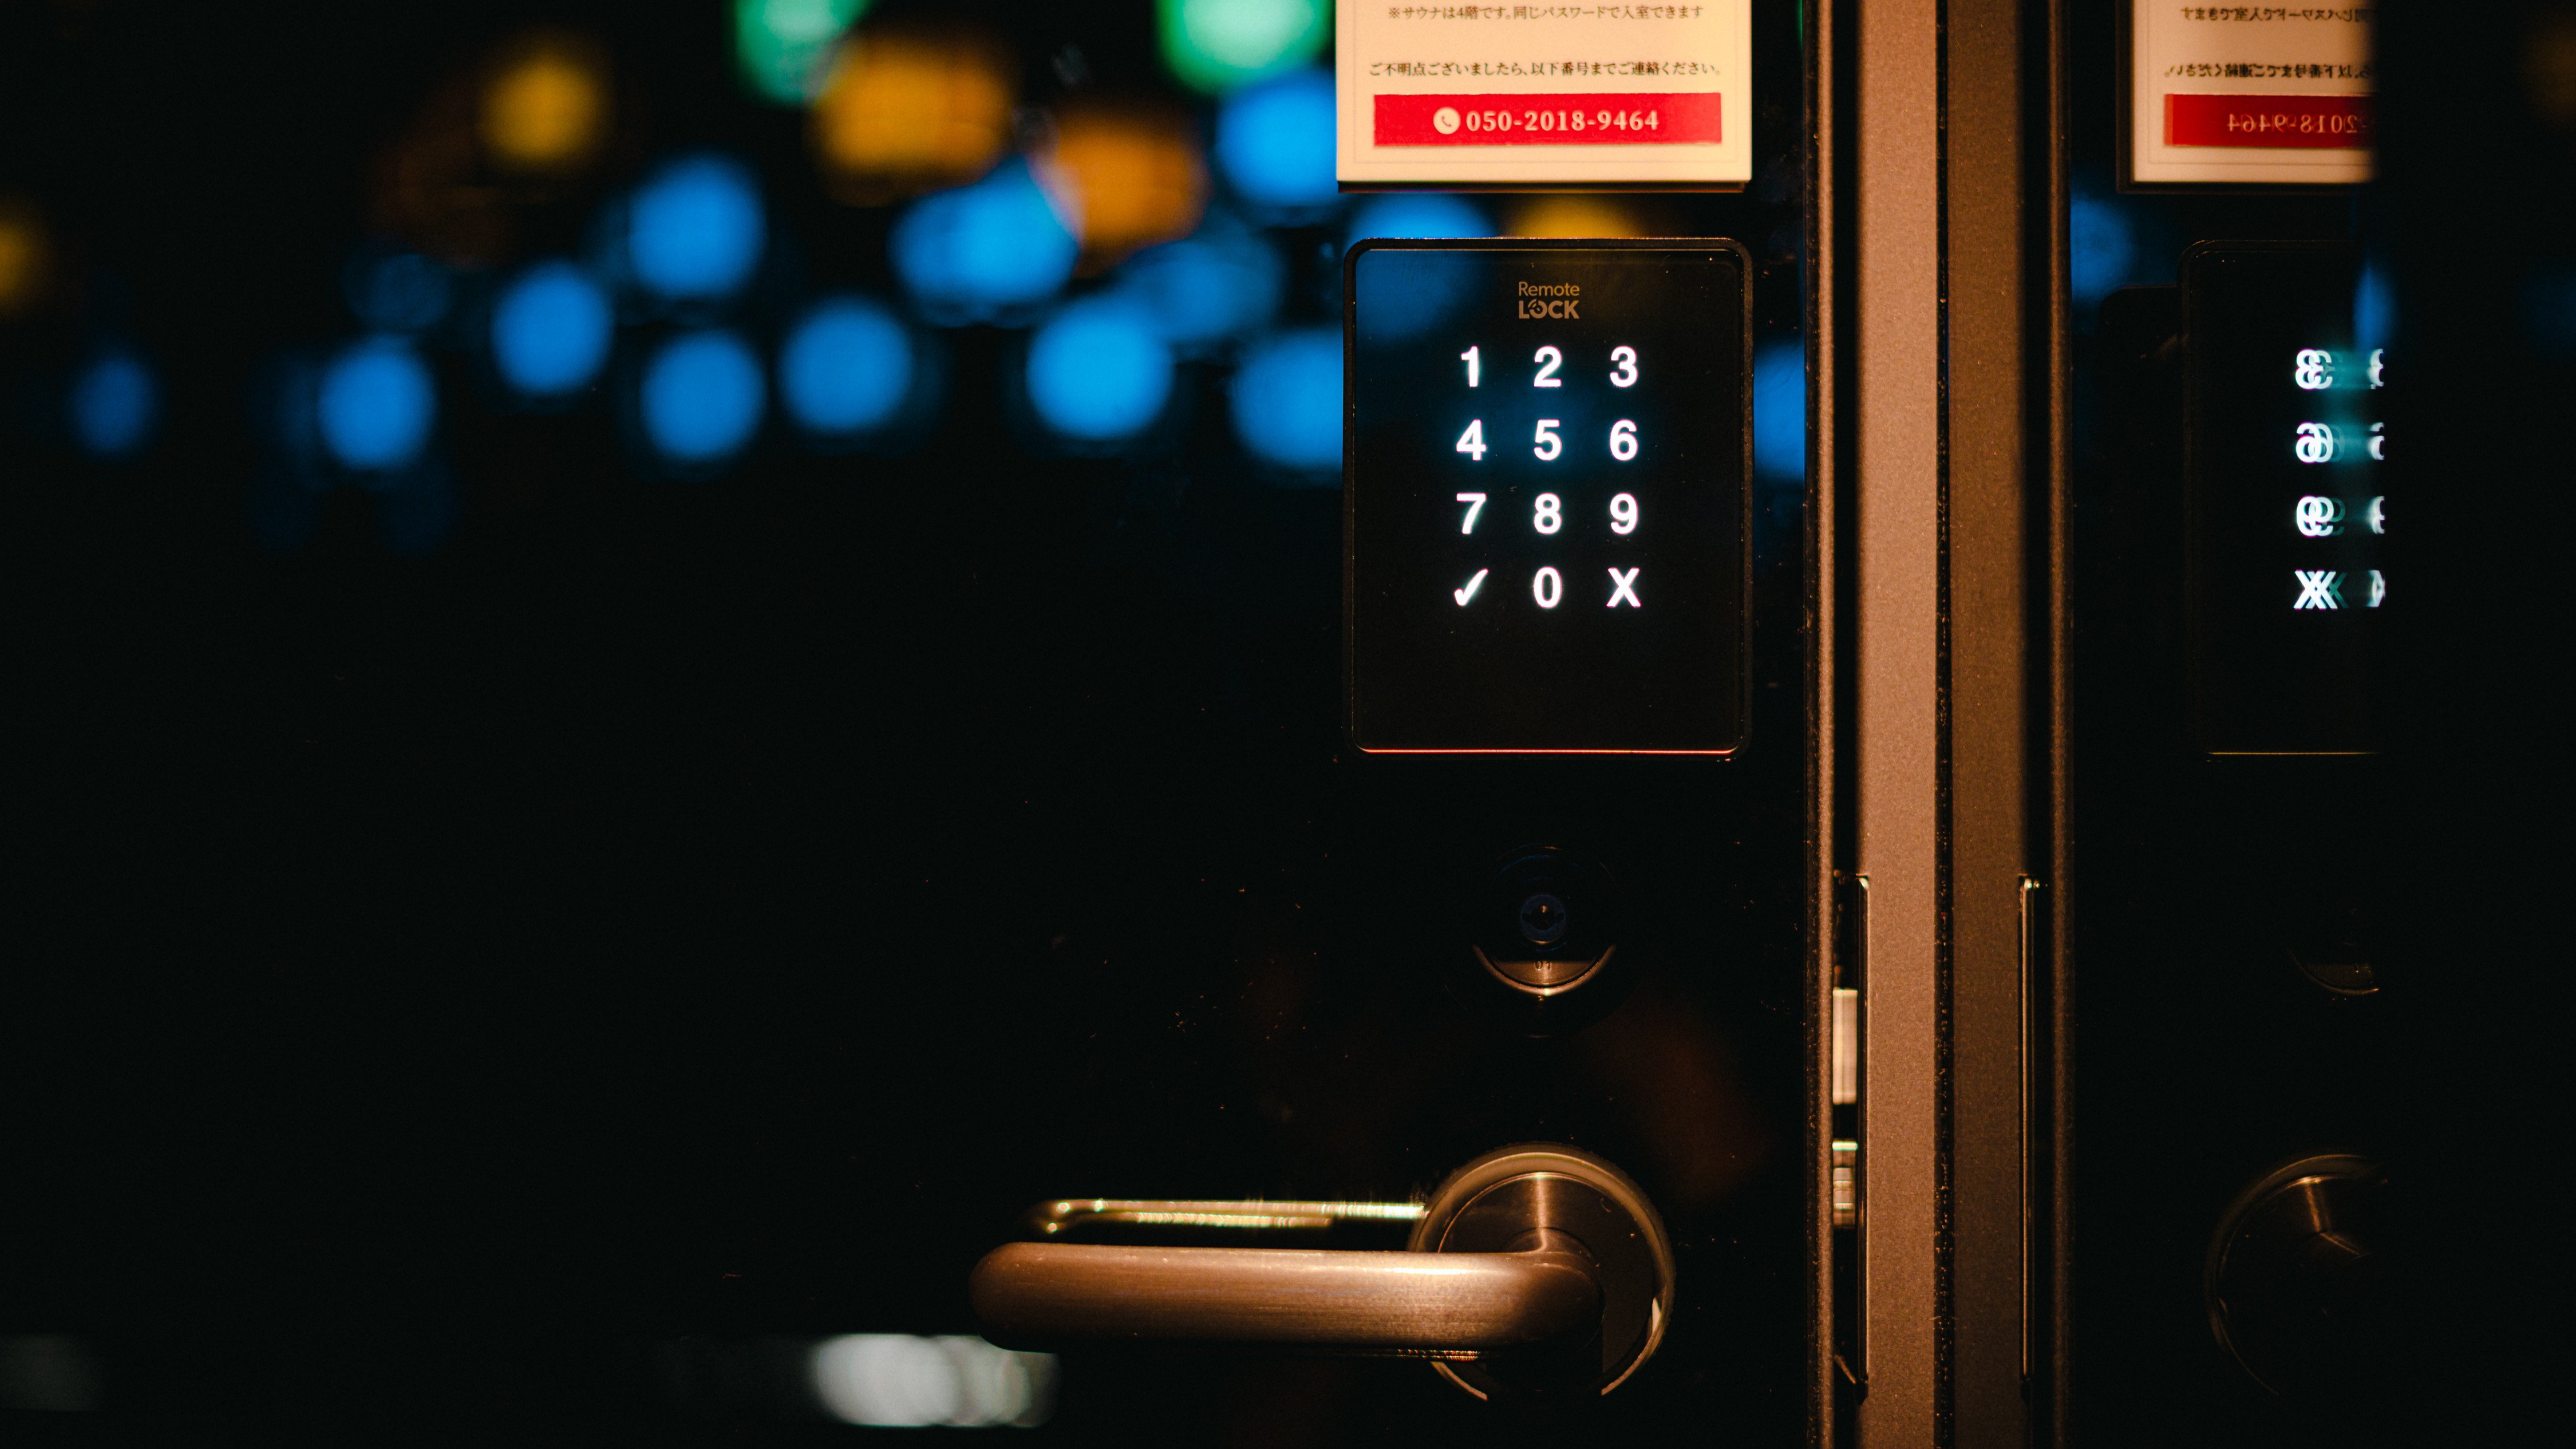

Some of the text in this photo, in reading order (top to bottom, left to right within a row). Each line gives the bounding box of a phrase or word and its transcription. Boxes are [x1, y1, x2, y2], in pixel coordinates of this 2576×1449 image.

[1466, 109, 1660, 132] 050-2018-9464
[1519, 281, 1580, 297] Remote
[1519, 299, 1579, 319] LOCK
[1461, 346, 1638, 388] 1 2 3
[1456, 419, 1638, 461] 4 5 6
[1456, 493, 1638, 535] 7 8 9
[1532, 567, 1641, 609] 0 X
